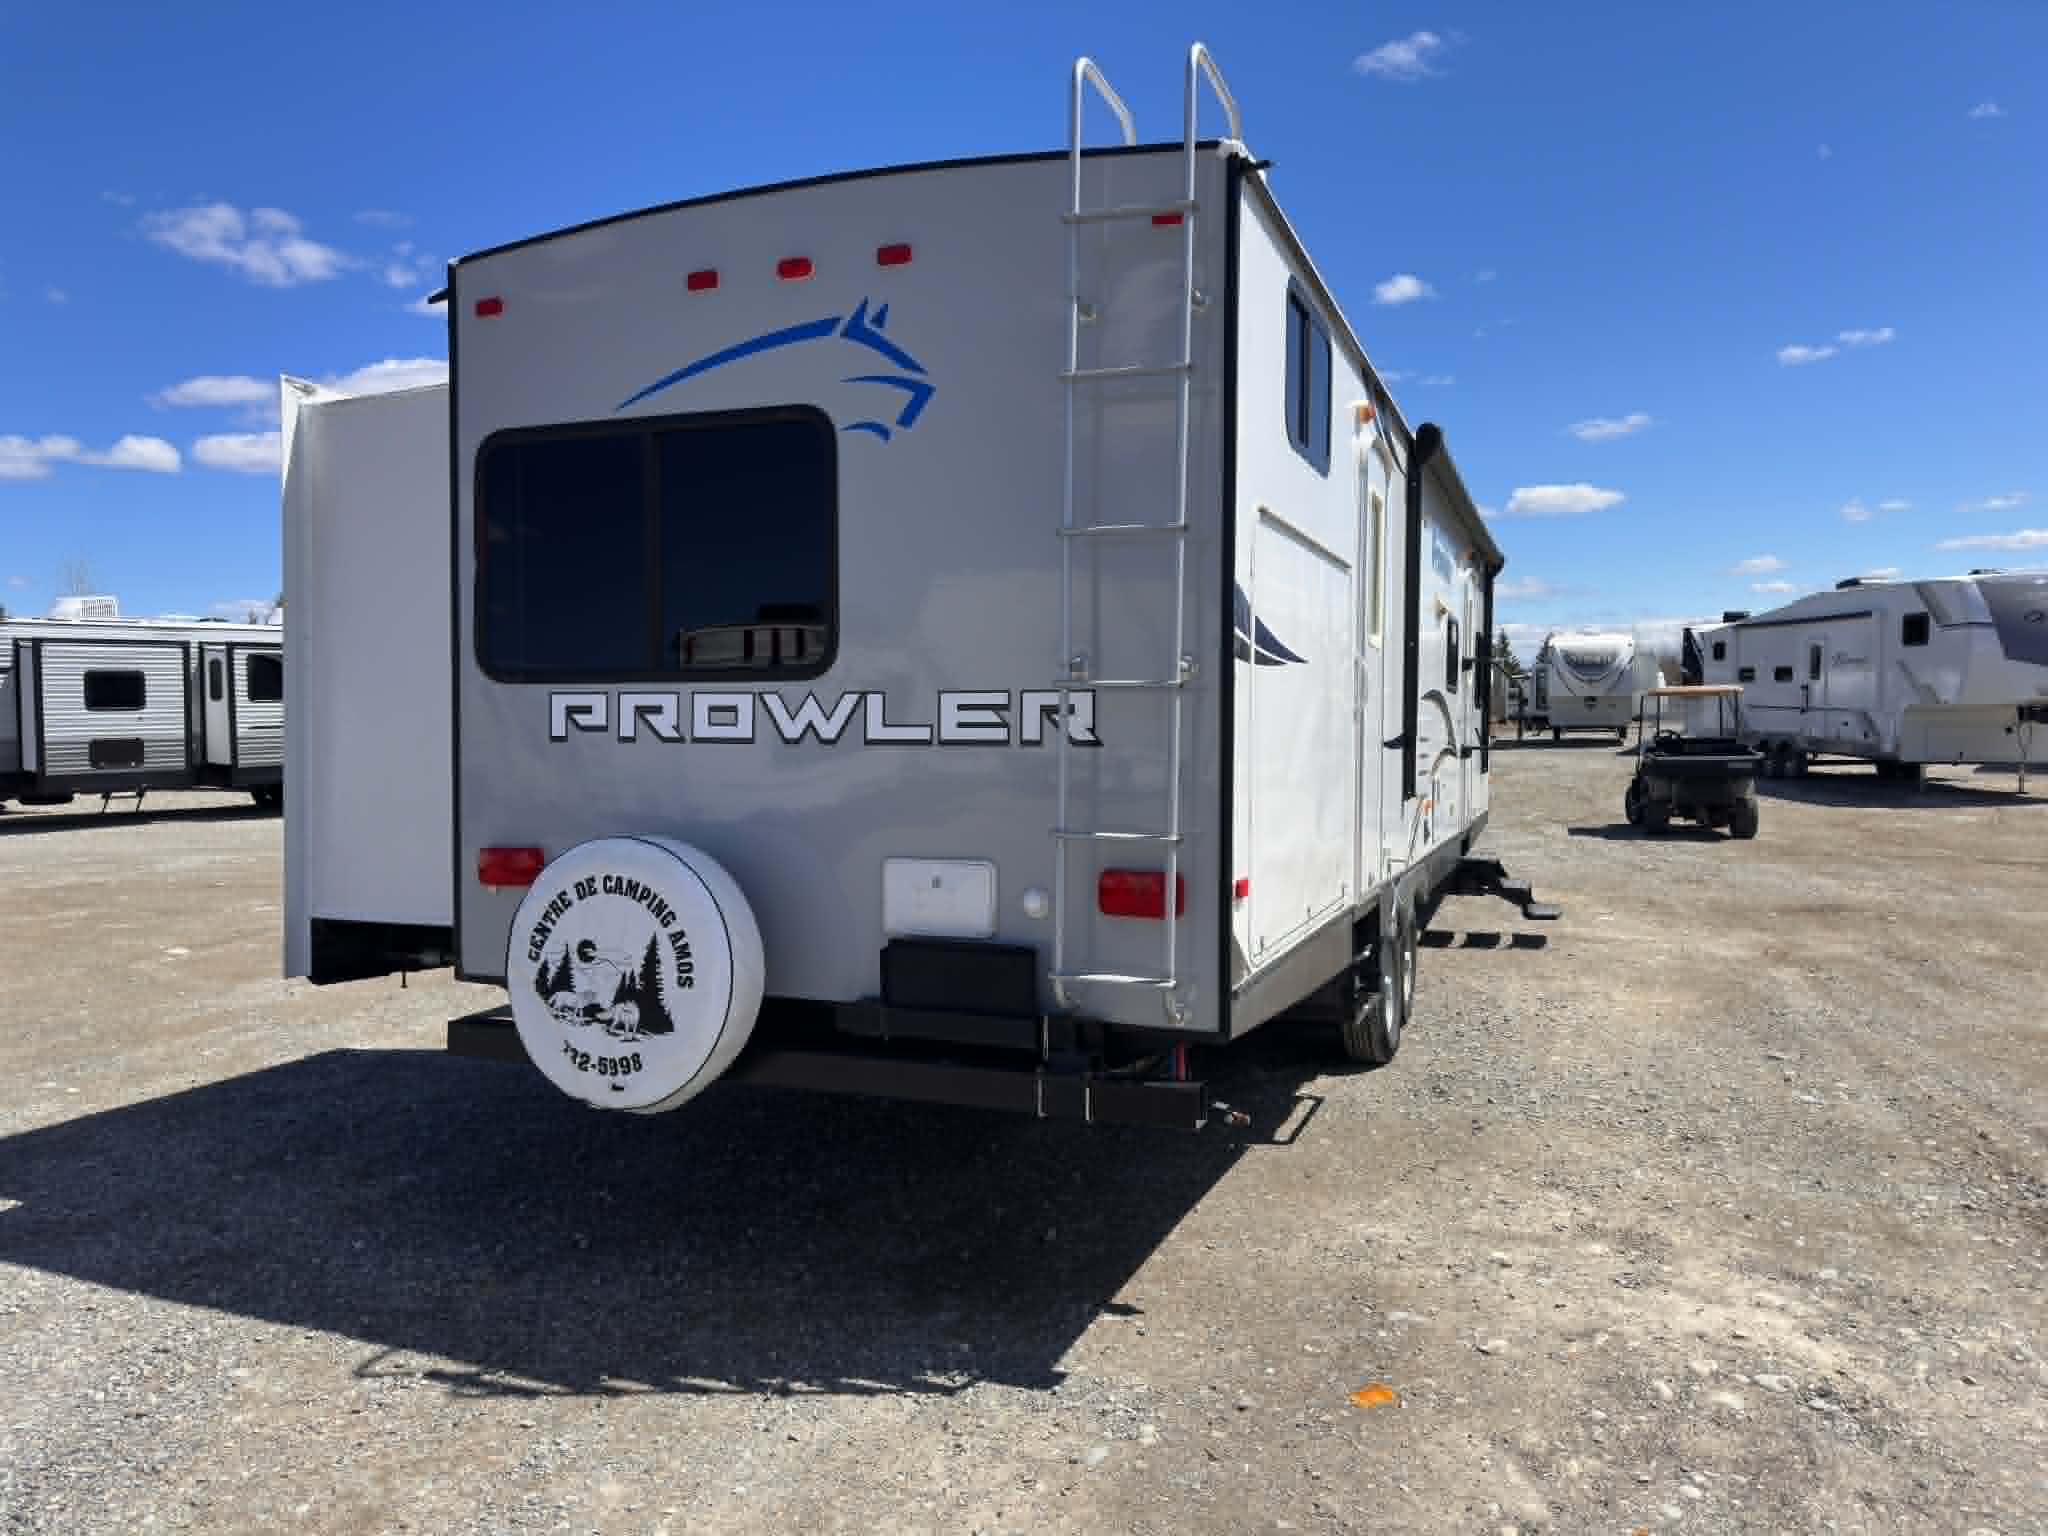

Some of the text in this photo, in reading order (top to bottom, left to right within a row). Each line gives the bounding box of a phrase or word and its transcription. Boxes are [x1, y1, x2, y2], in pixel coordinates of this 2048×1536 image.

[550, 690, 1104, 746] PROWLER
[528, 873, 695, 990] CENTRE DE CAMPING AMOS
